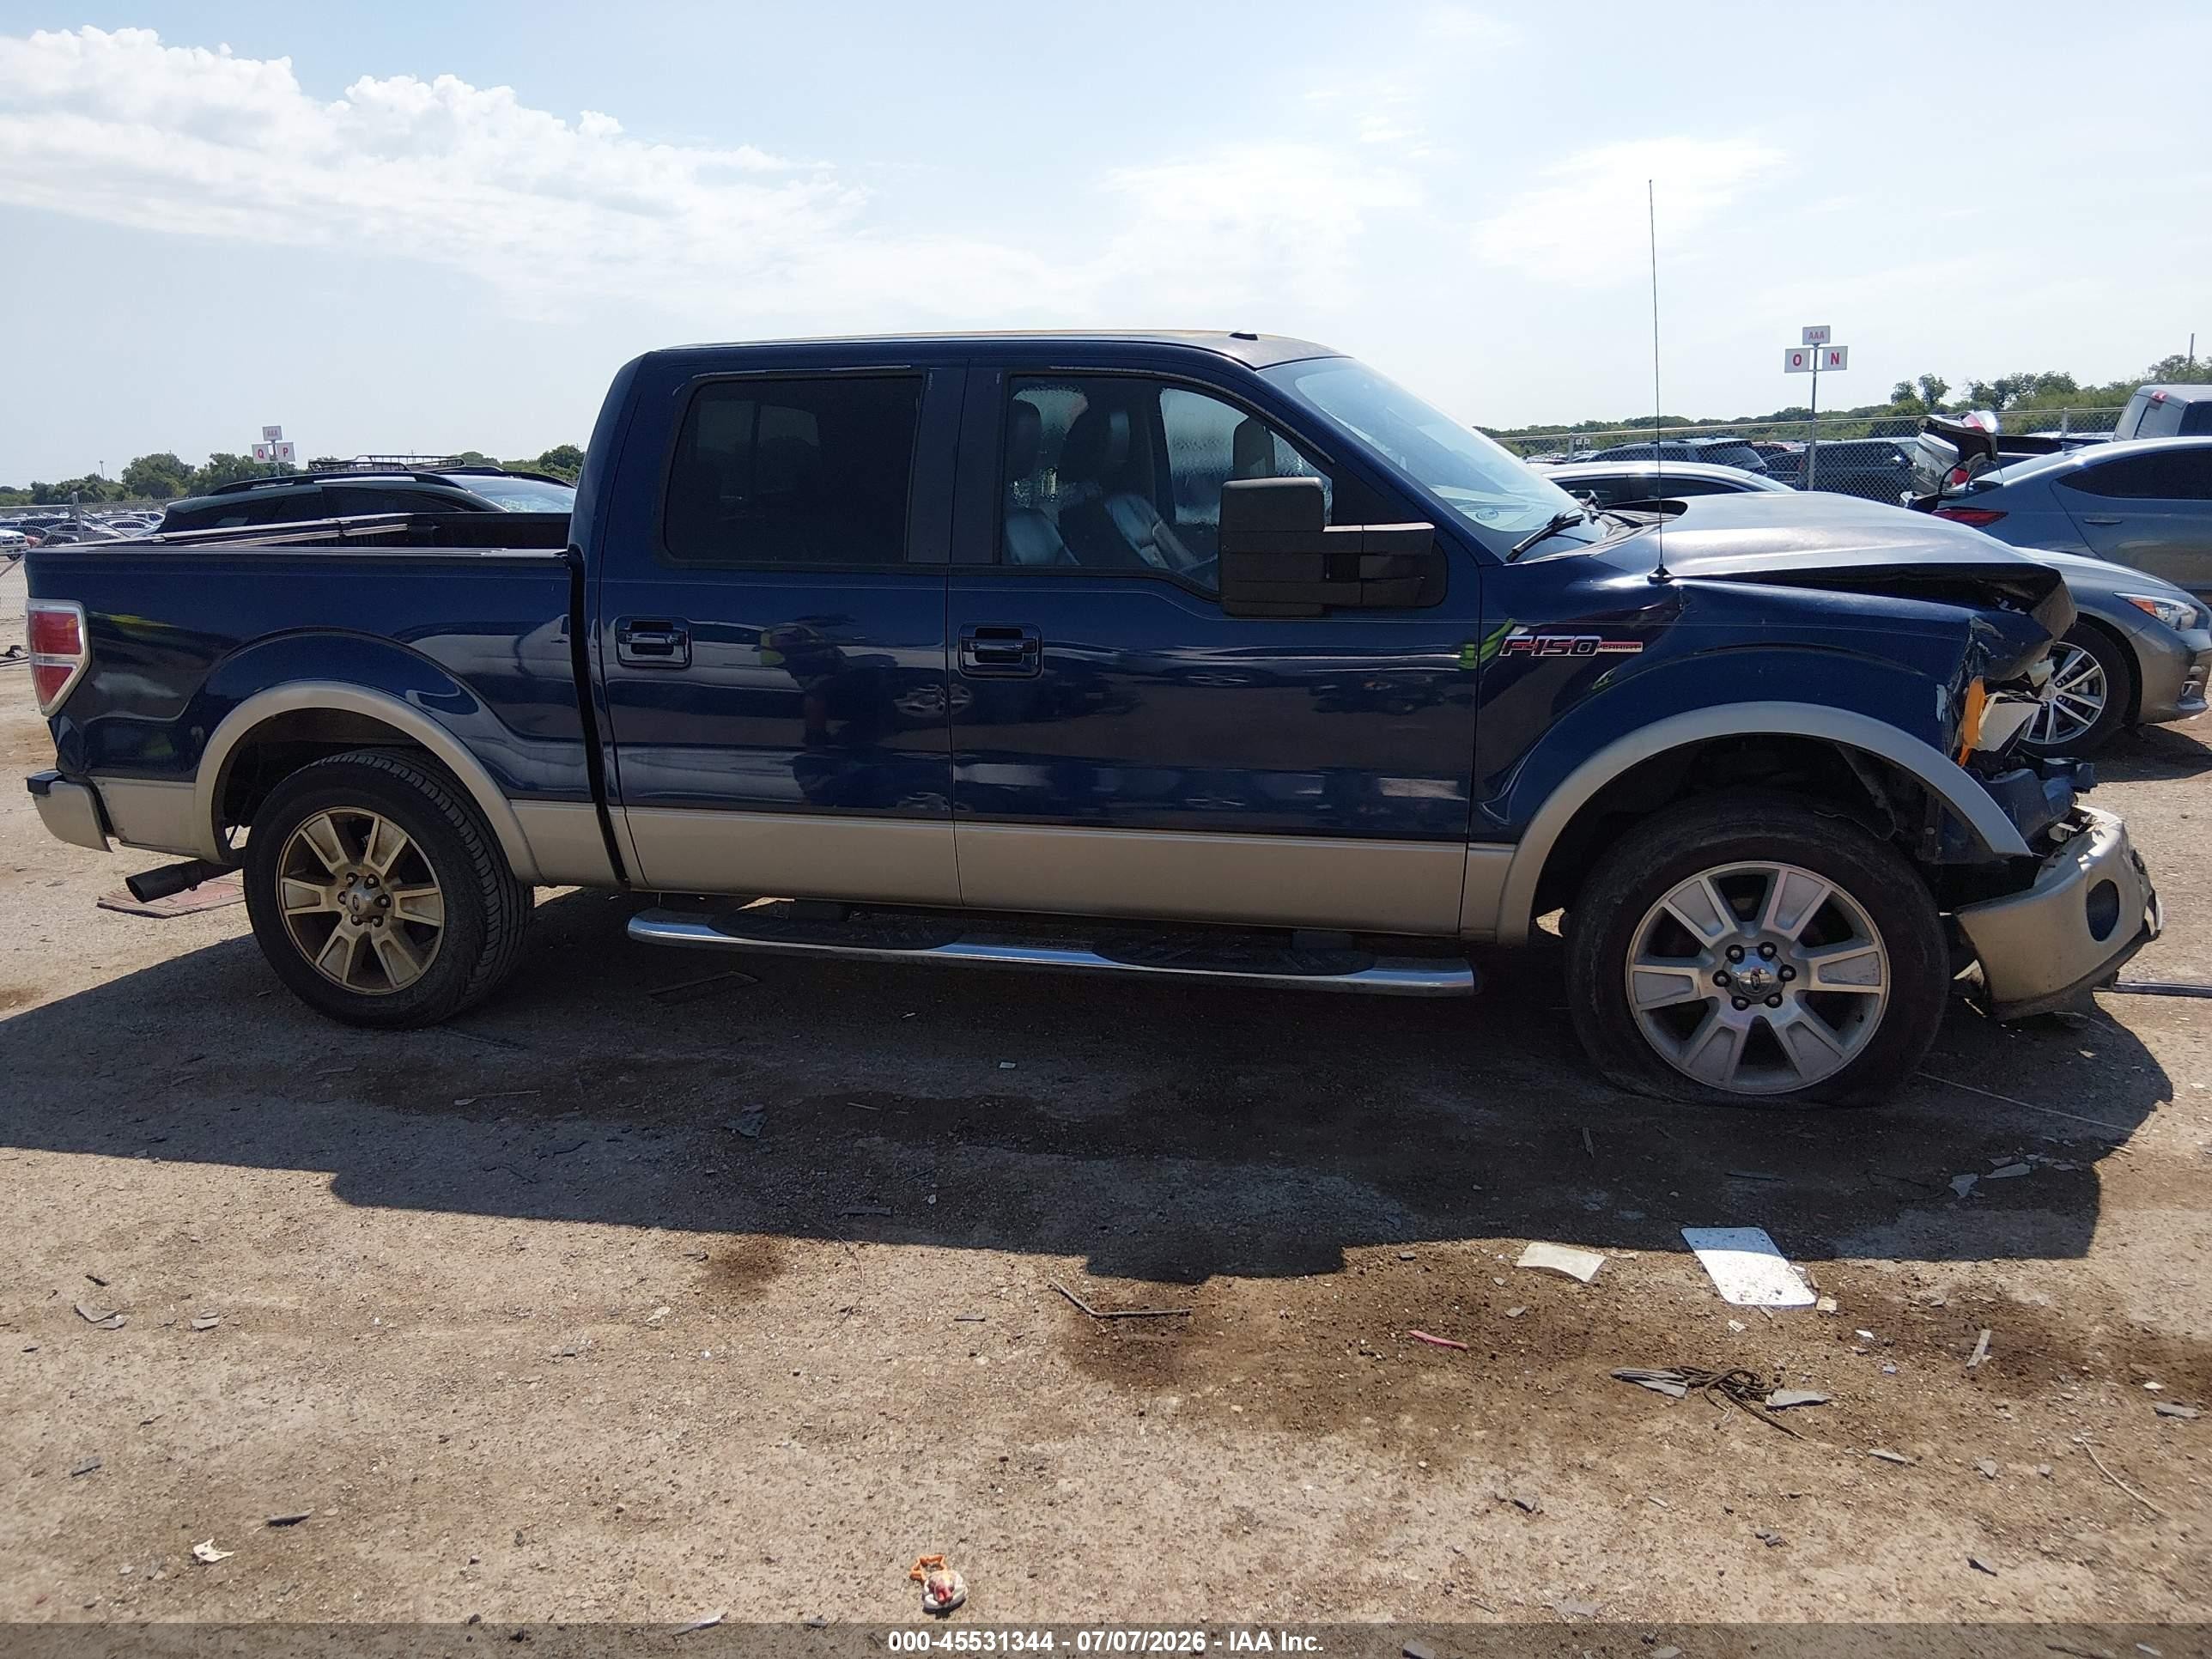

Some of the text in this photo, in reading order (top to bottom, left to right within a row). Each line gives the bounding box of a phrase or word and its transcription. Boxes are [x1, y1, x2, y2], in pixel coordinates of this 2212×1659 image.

[1808, 331, 1825, 340] AAA
[1792, 354, 1802, 367] O
[1830, 352, 1840, 365] N
[258, 448, 264, 459] Q
[283, 447, 289, 458] P
[1498, 635, 1602, 657] F-150
